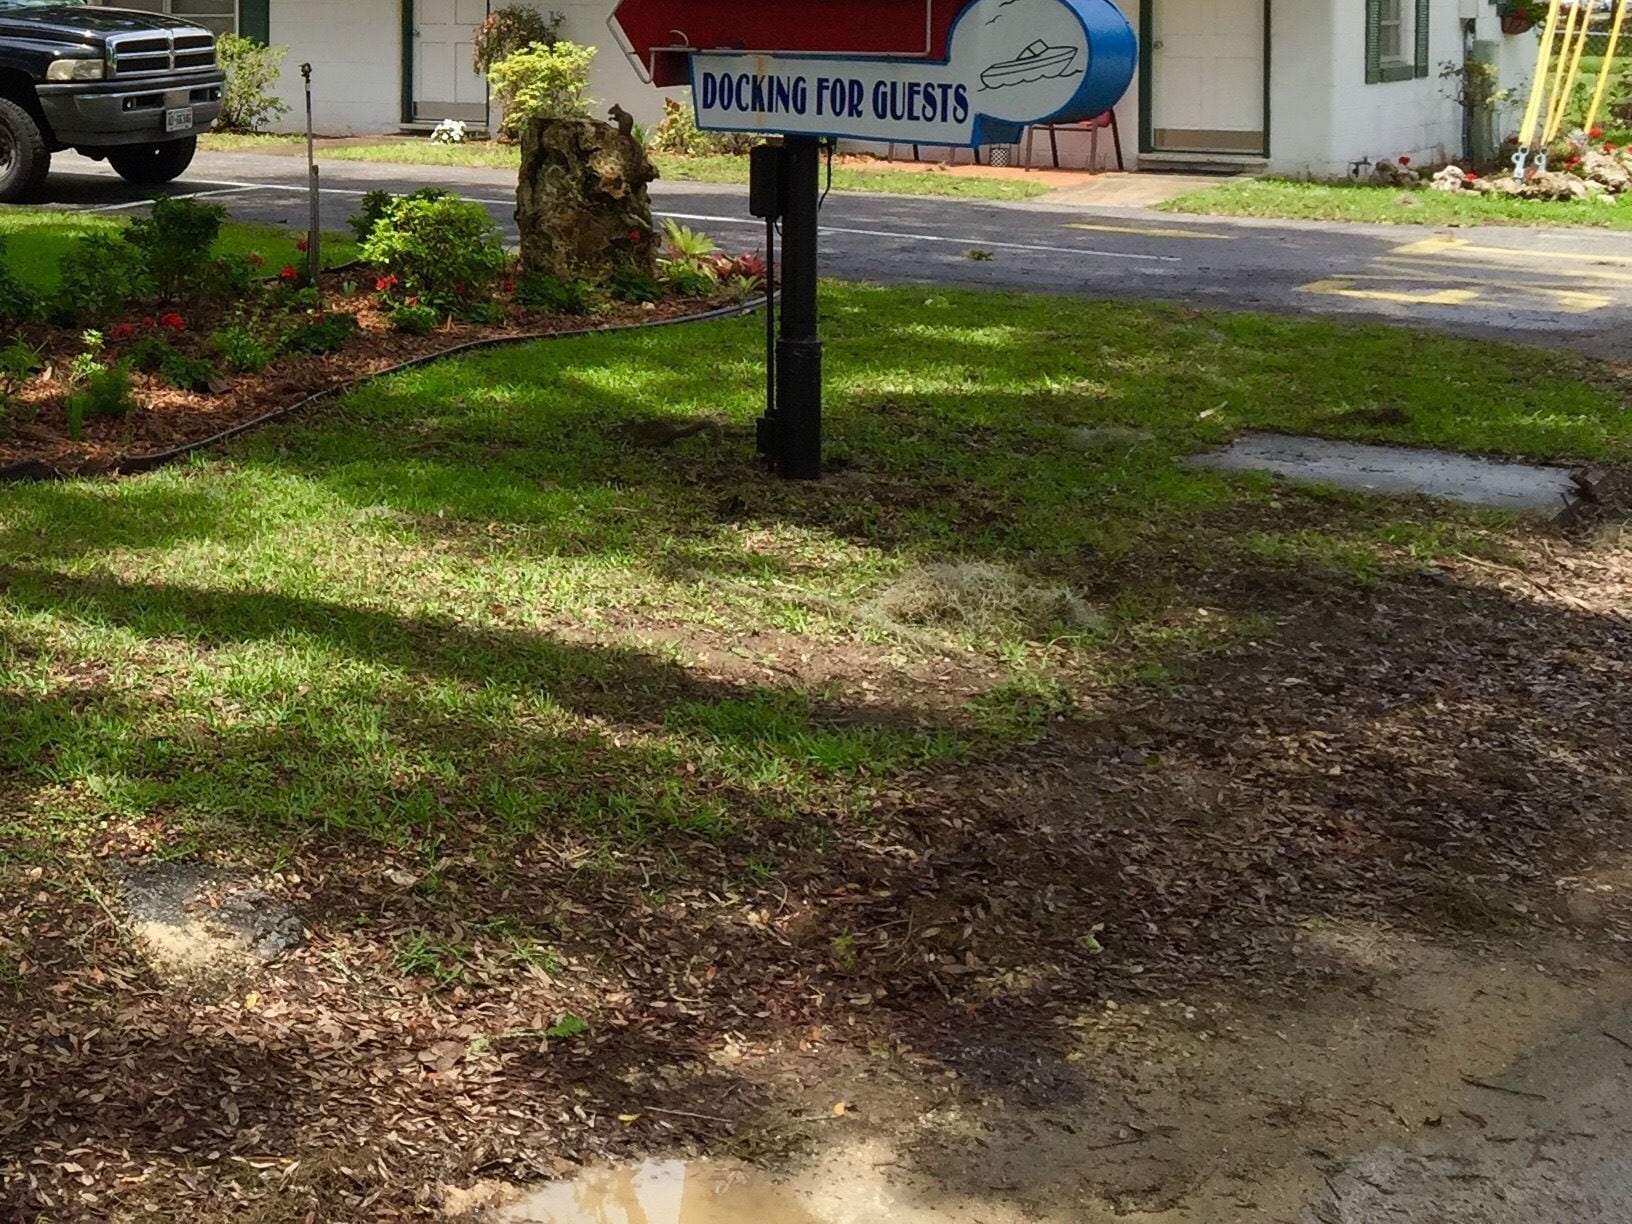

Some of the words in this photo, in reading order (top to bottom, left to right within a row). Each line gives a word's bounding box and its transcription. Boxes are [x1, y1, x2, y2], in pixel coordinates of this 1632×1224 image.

[702, 71, 807, 115] DOCKING
[816, 77, 864, 118] FOR
[872, 80, 969, 124] GUESTS
